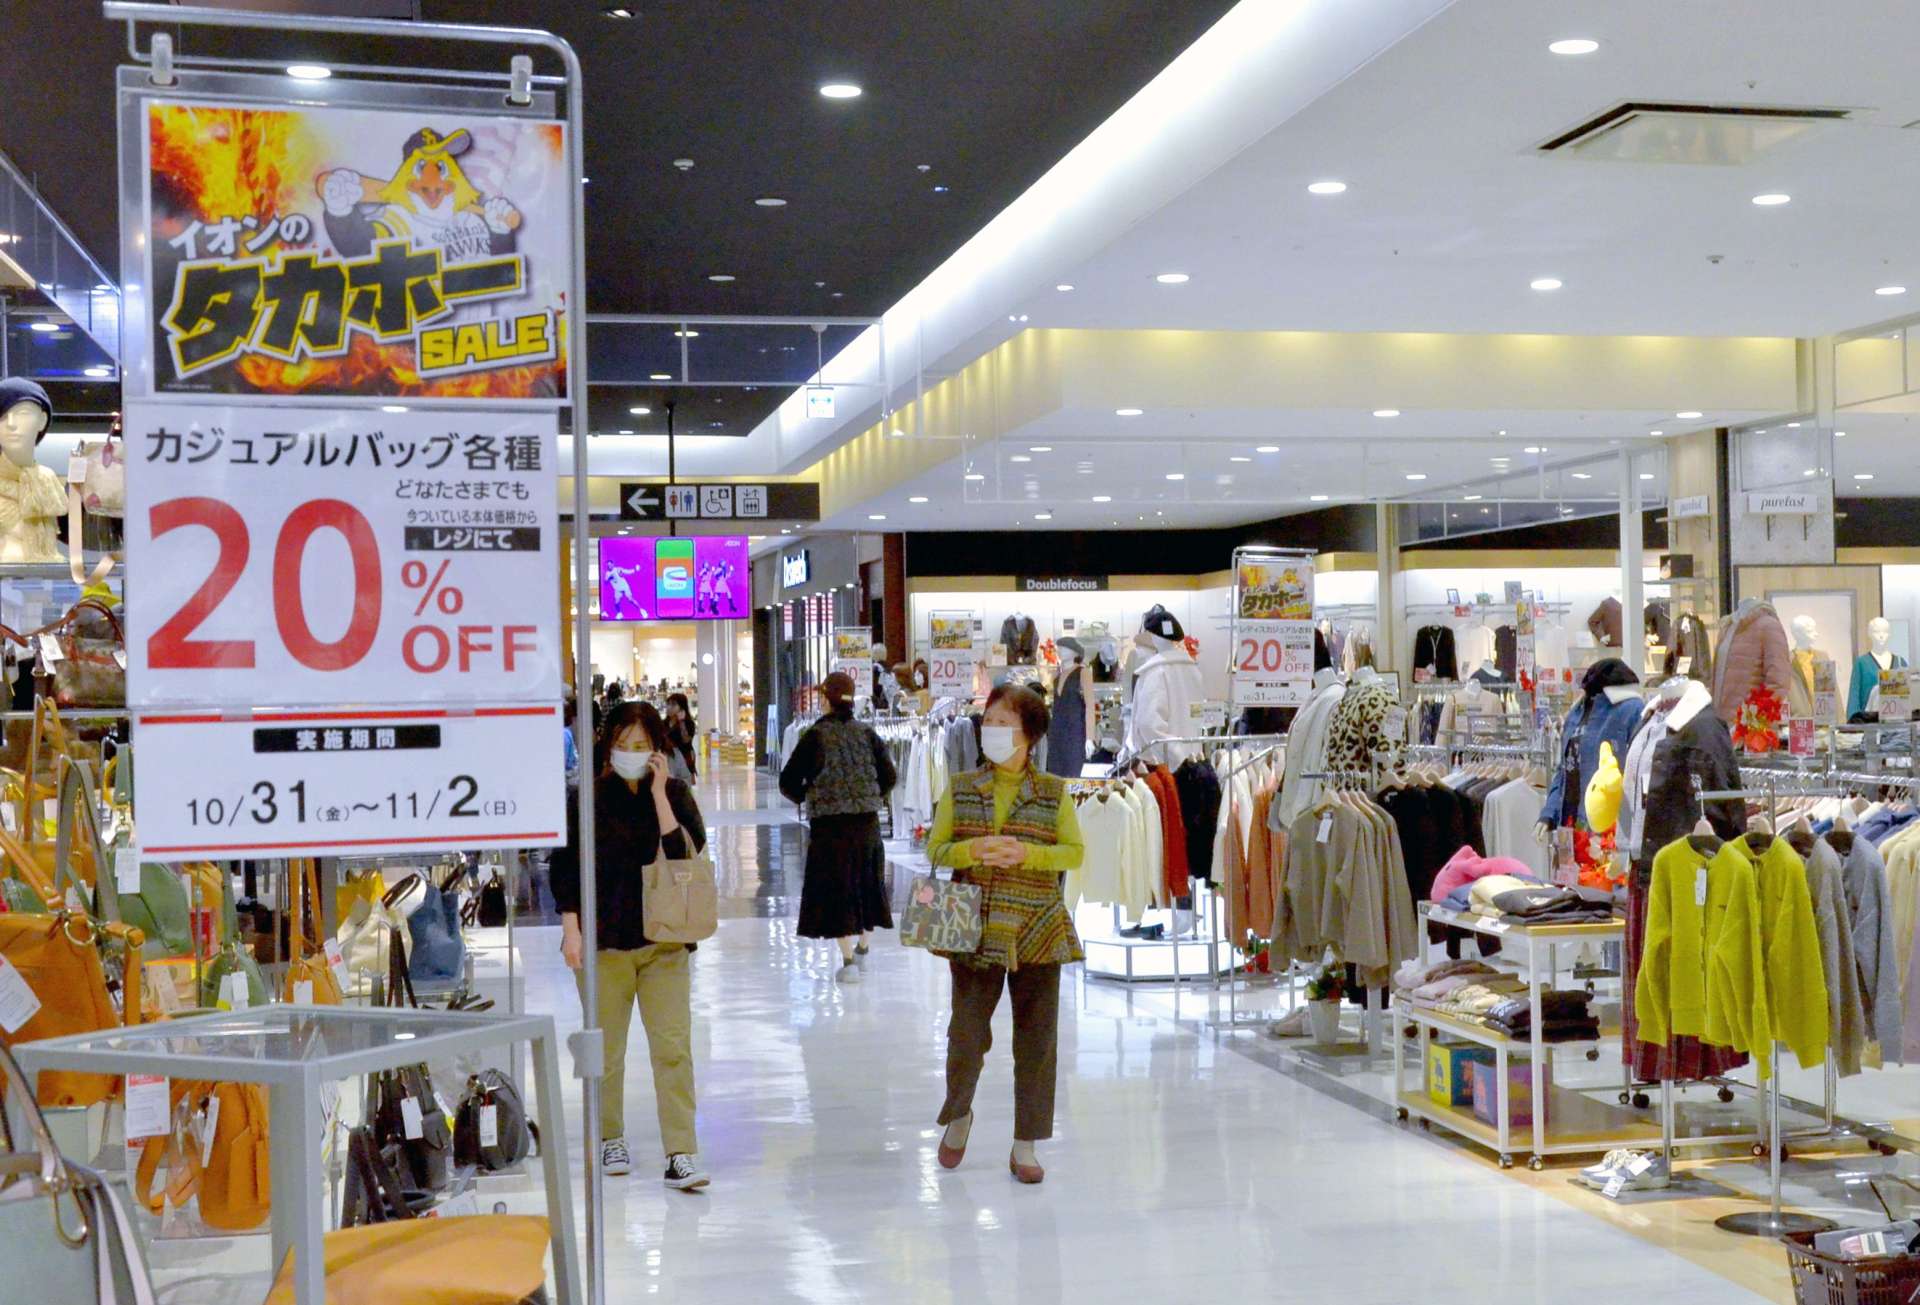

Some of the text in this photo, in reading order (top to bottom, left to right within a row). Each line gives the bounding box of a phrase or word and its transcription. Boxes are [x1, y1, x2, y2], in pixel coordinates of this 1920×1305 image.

[170, 213, 311, 259] イオンの
[163, 239, 526, 377] タカホー
[419, 312, 551, 373] SALE
[146, 427, 542, 472] カジュアルバッグ各種
[396, 479, 529, 500] どなたさまでも
[407, 508, 537, 524] 今ついている本体価格から
[433, 528, 513, 550] レジにて
[147, 496, 382, 671] 20
[1026, 578, 1098, 590] Doublefocus
[401, 625, 537, 673] OFF
[1240, 639, 1282, 672] 20
[932, 660, 955, 678] 20
[296, 727, 396, 751] 実施期間
